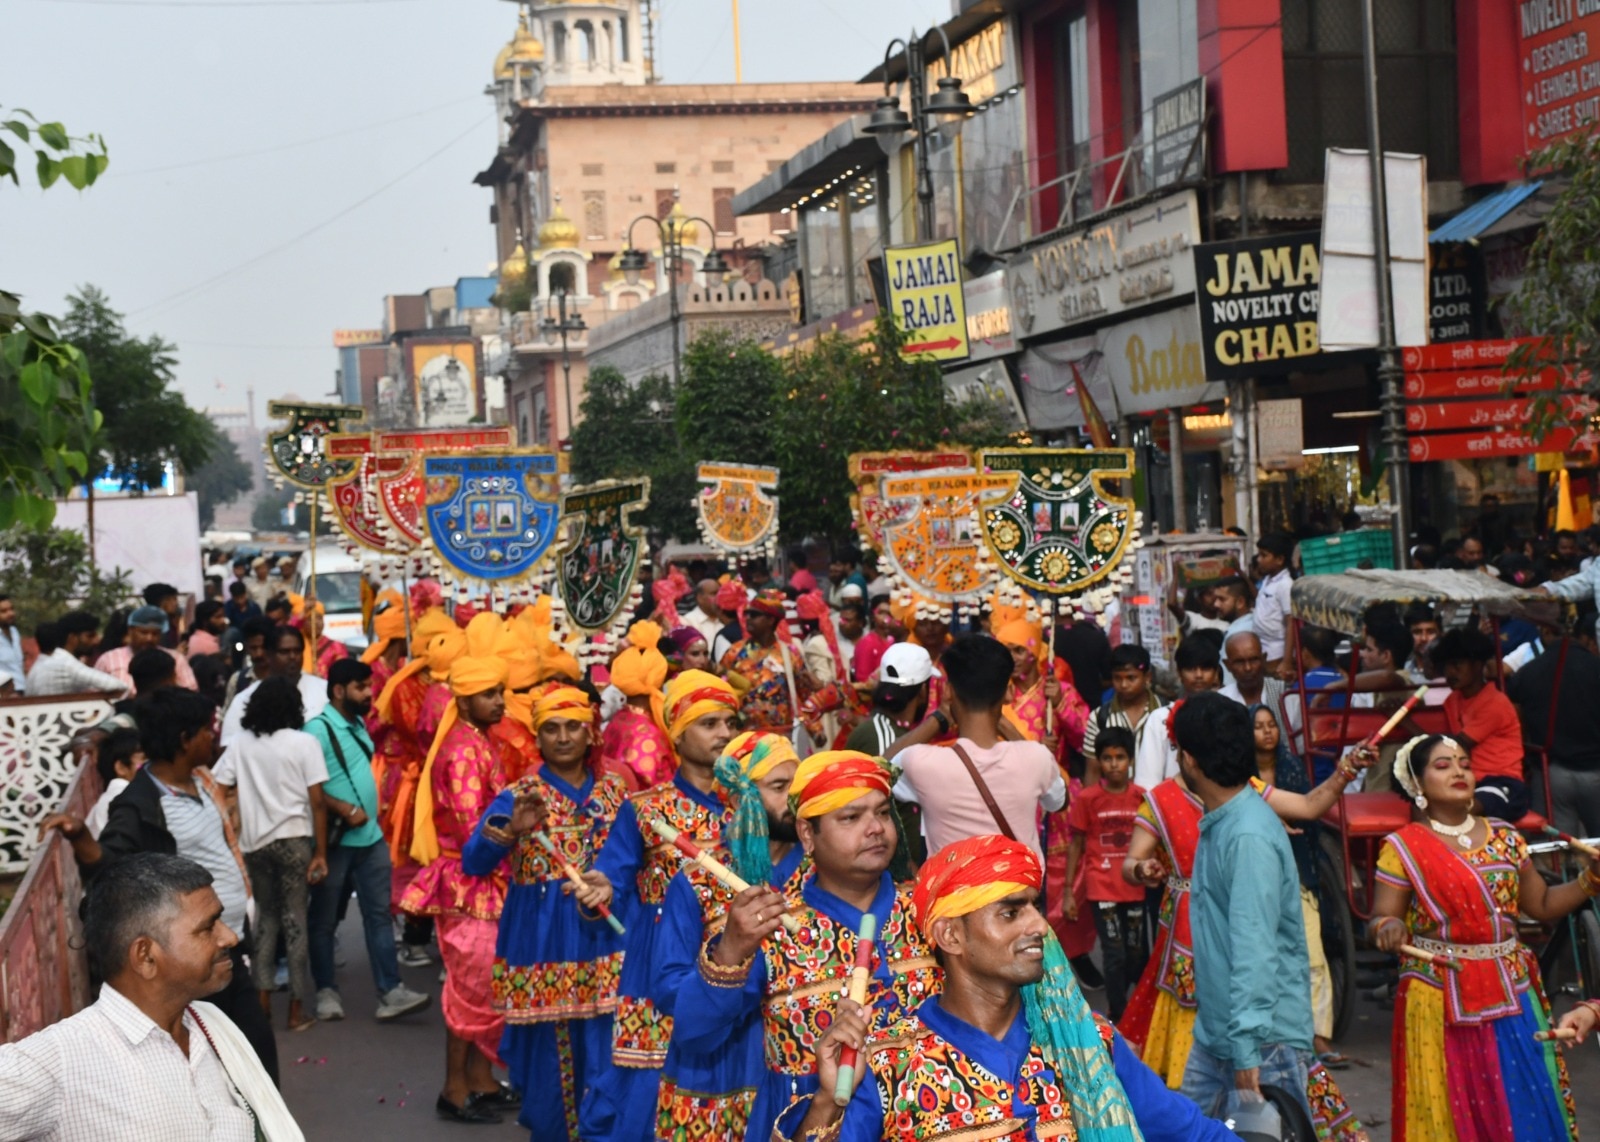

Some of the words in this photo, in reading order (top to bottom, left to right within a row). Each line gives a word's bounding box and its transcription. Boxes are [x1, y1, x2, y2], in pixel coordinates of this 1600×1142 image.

[1532, 31, 1588, 75] DESIGNER
[1534, 69, 1579, 107] LEHNGA
[1537, 105, 1573, 139] SAREE
[893, 253, 956, 290] JAMAI
[1032, 221, 1123, 297] NOVELTY
[1206, 243, 1320, 297] JAMA
[1433, 274, 1472, 298] LTD.
[902, 294, 956, 329] RAJA
[1212, 293, 1294, 324] NOVELTY
[1215, 320, 1320, 366] CHAB
[1452, 344, 1474, 360] गली
[1126, 327, 1204, 396] Bata
[1456, 376, 1479, 389] Gali
[986, 457, 1024, 469] PHOOL
[1029, 457, 1077, 469] WAALON
[1080, 457, 1094, 469] KI
[972, 477, 982, 487] KI
[986, 476, 1009, 487] SAIR
